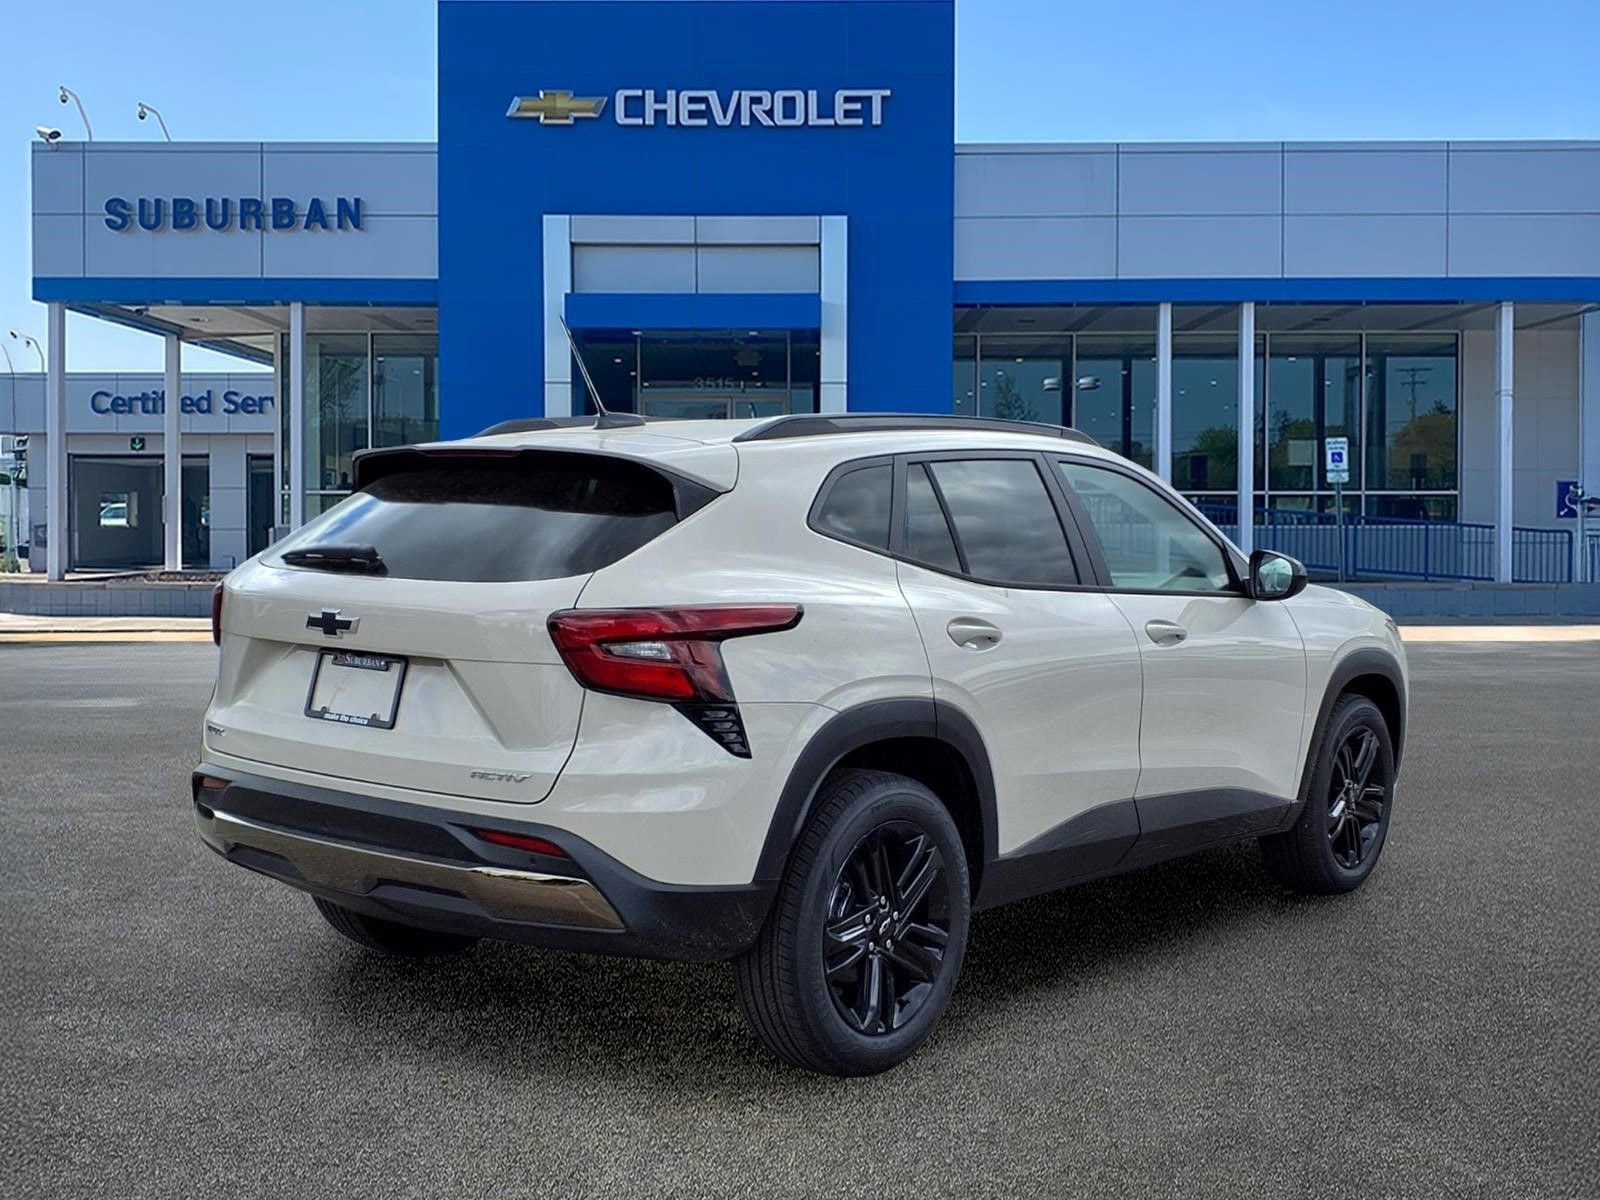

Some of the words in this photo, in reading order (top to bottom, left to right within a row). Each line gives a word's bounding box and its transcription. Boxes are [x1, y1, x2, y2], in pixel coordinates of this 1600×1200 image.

[615, 89, 891, 127] CHEVROLET
[104, 197, 363, 231] SUBURBAN
[90, 390, 212, 415] Certifed
